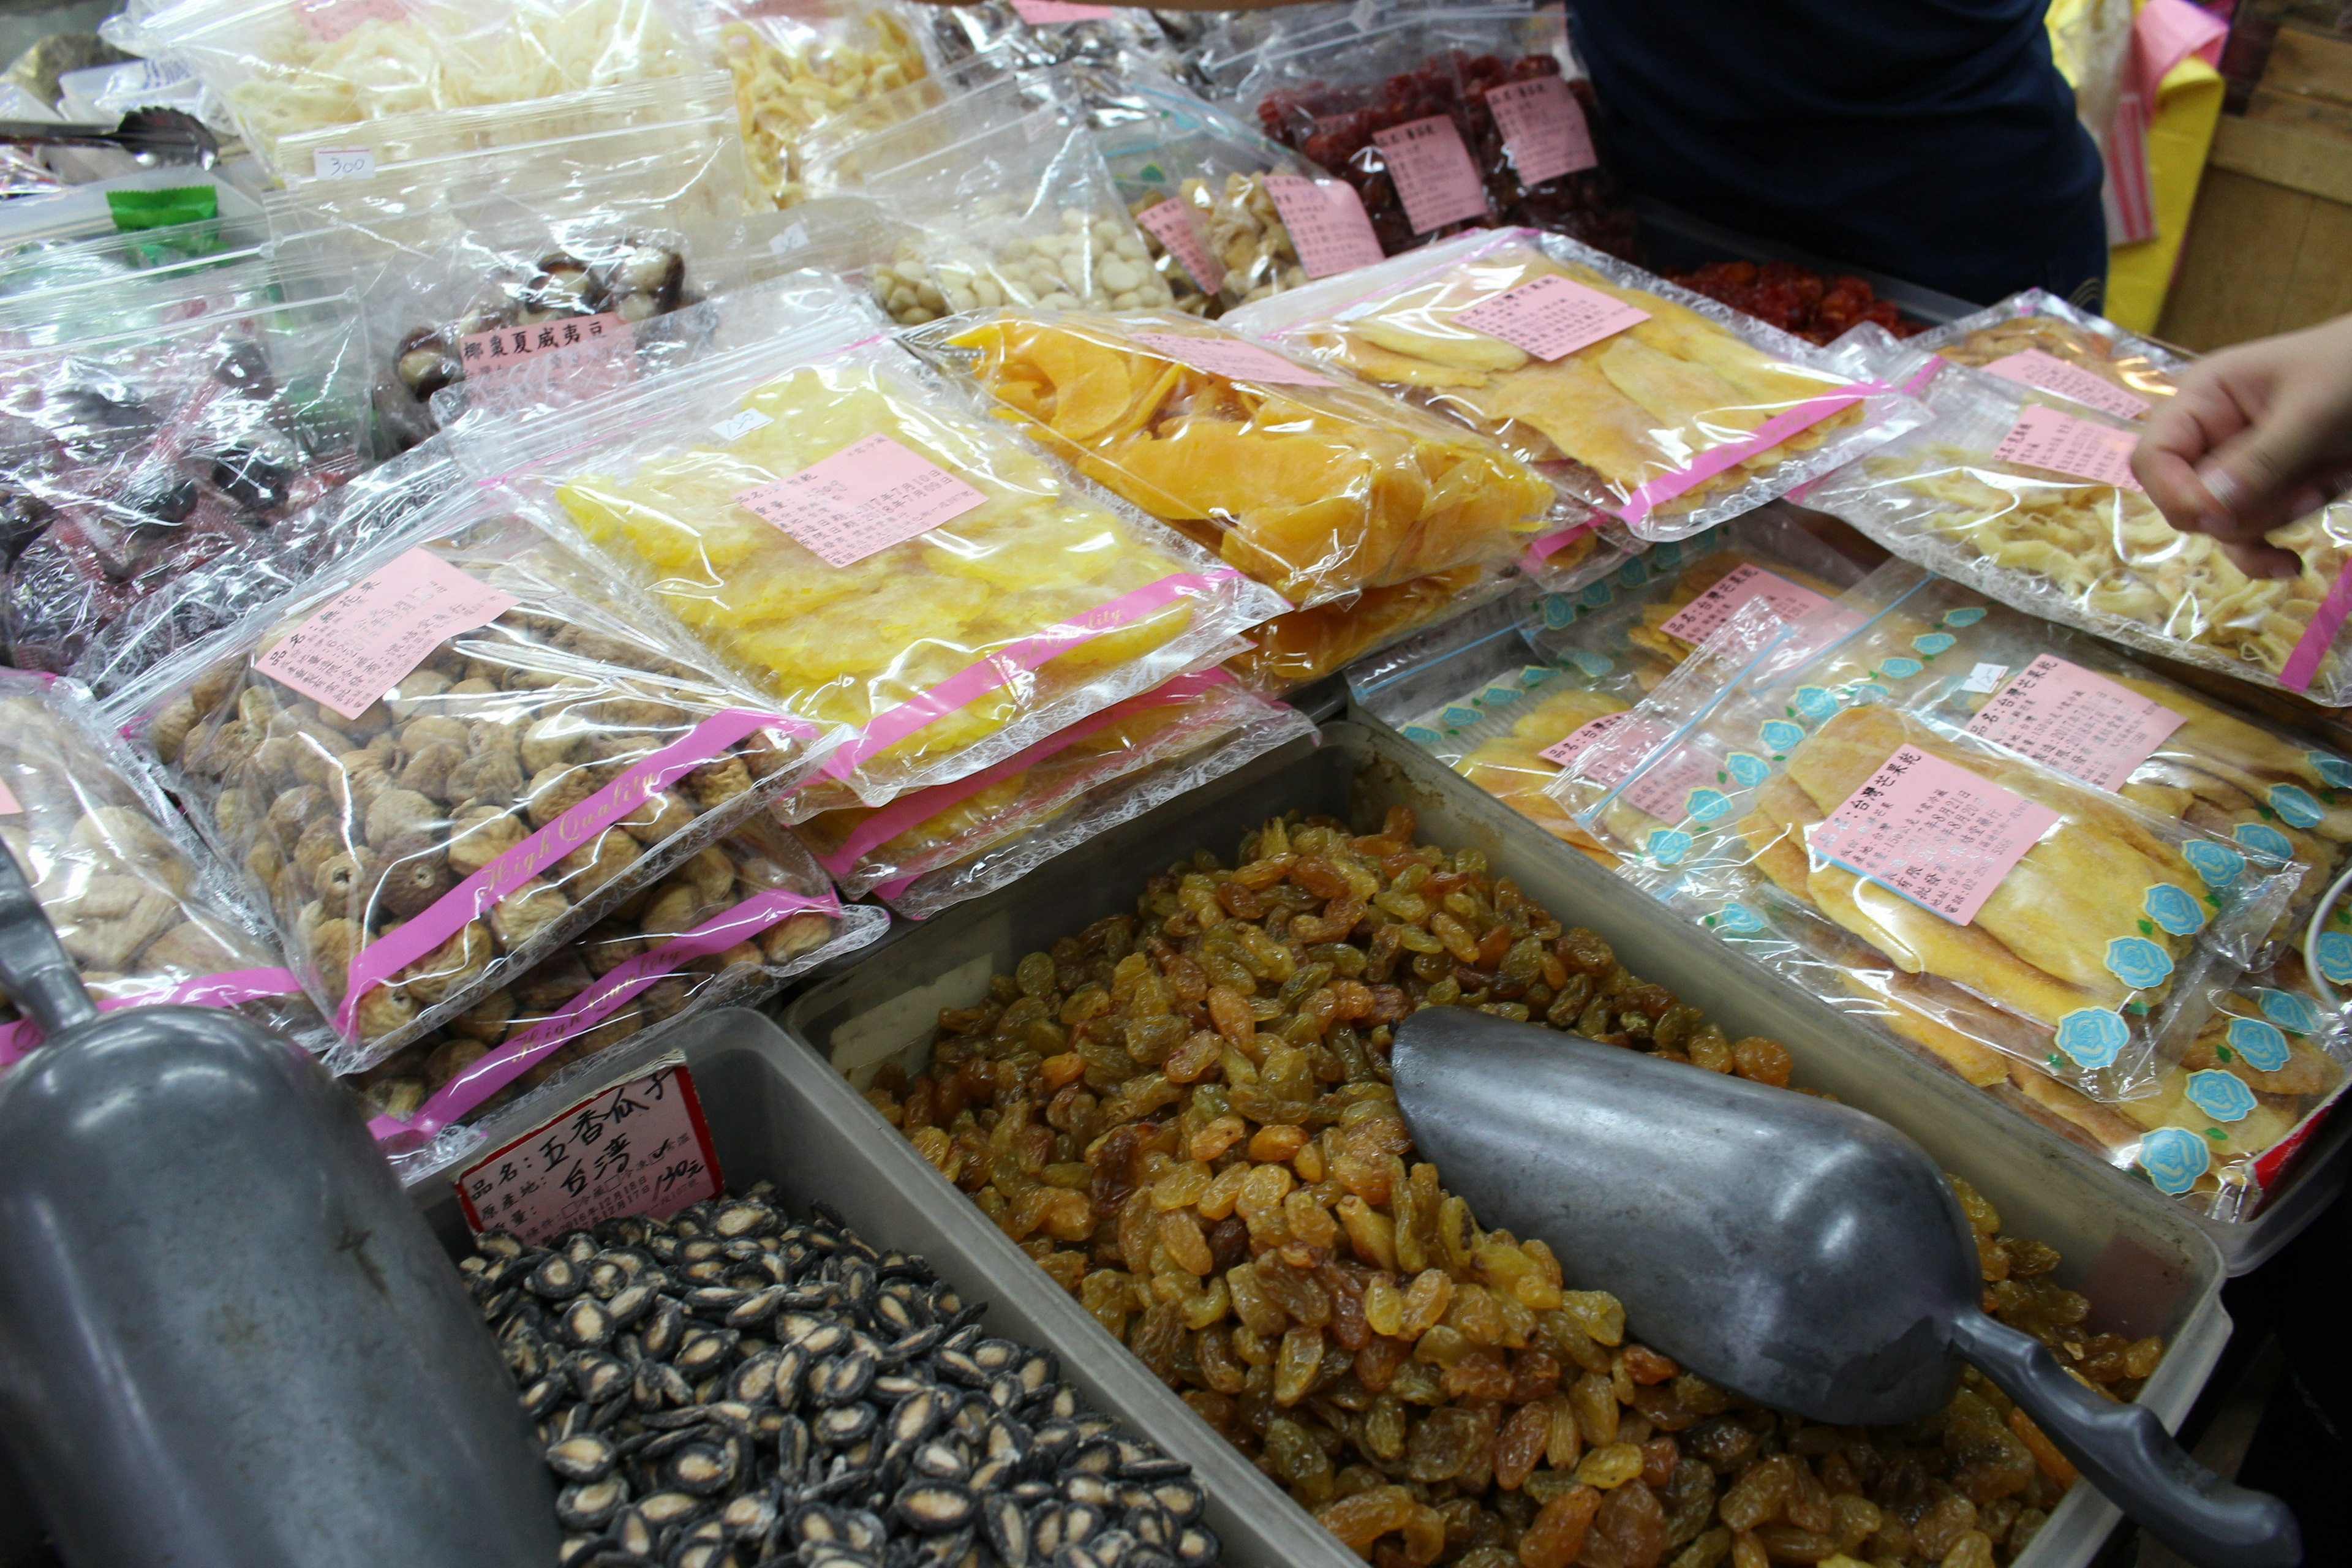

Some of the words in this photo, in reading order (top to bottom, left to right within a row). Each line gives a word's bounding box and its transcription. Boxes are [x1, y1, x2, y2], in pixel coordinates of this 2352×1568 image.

[331, 157, 364, 176] 300
[479, 840, 552, 896] High
[559, 770, 658, 843] Quality
[1813, 749, 1923, 850] 品名:台灣芒果乾
